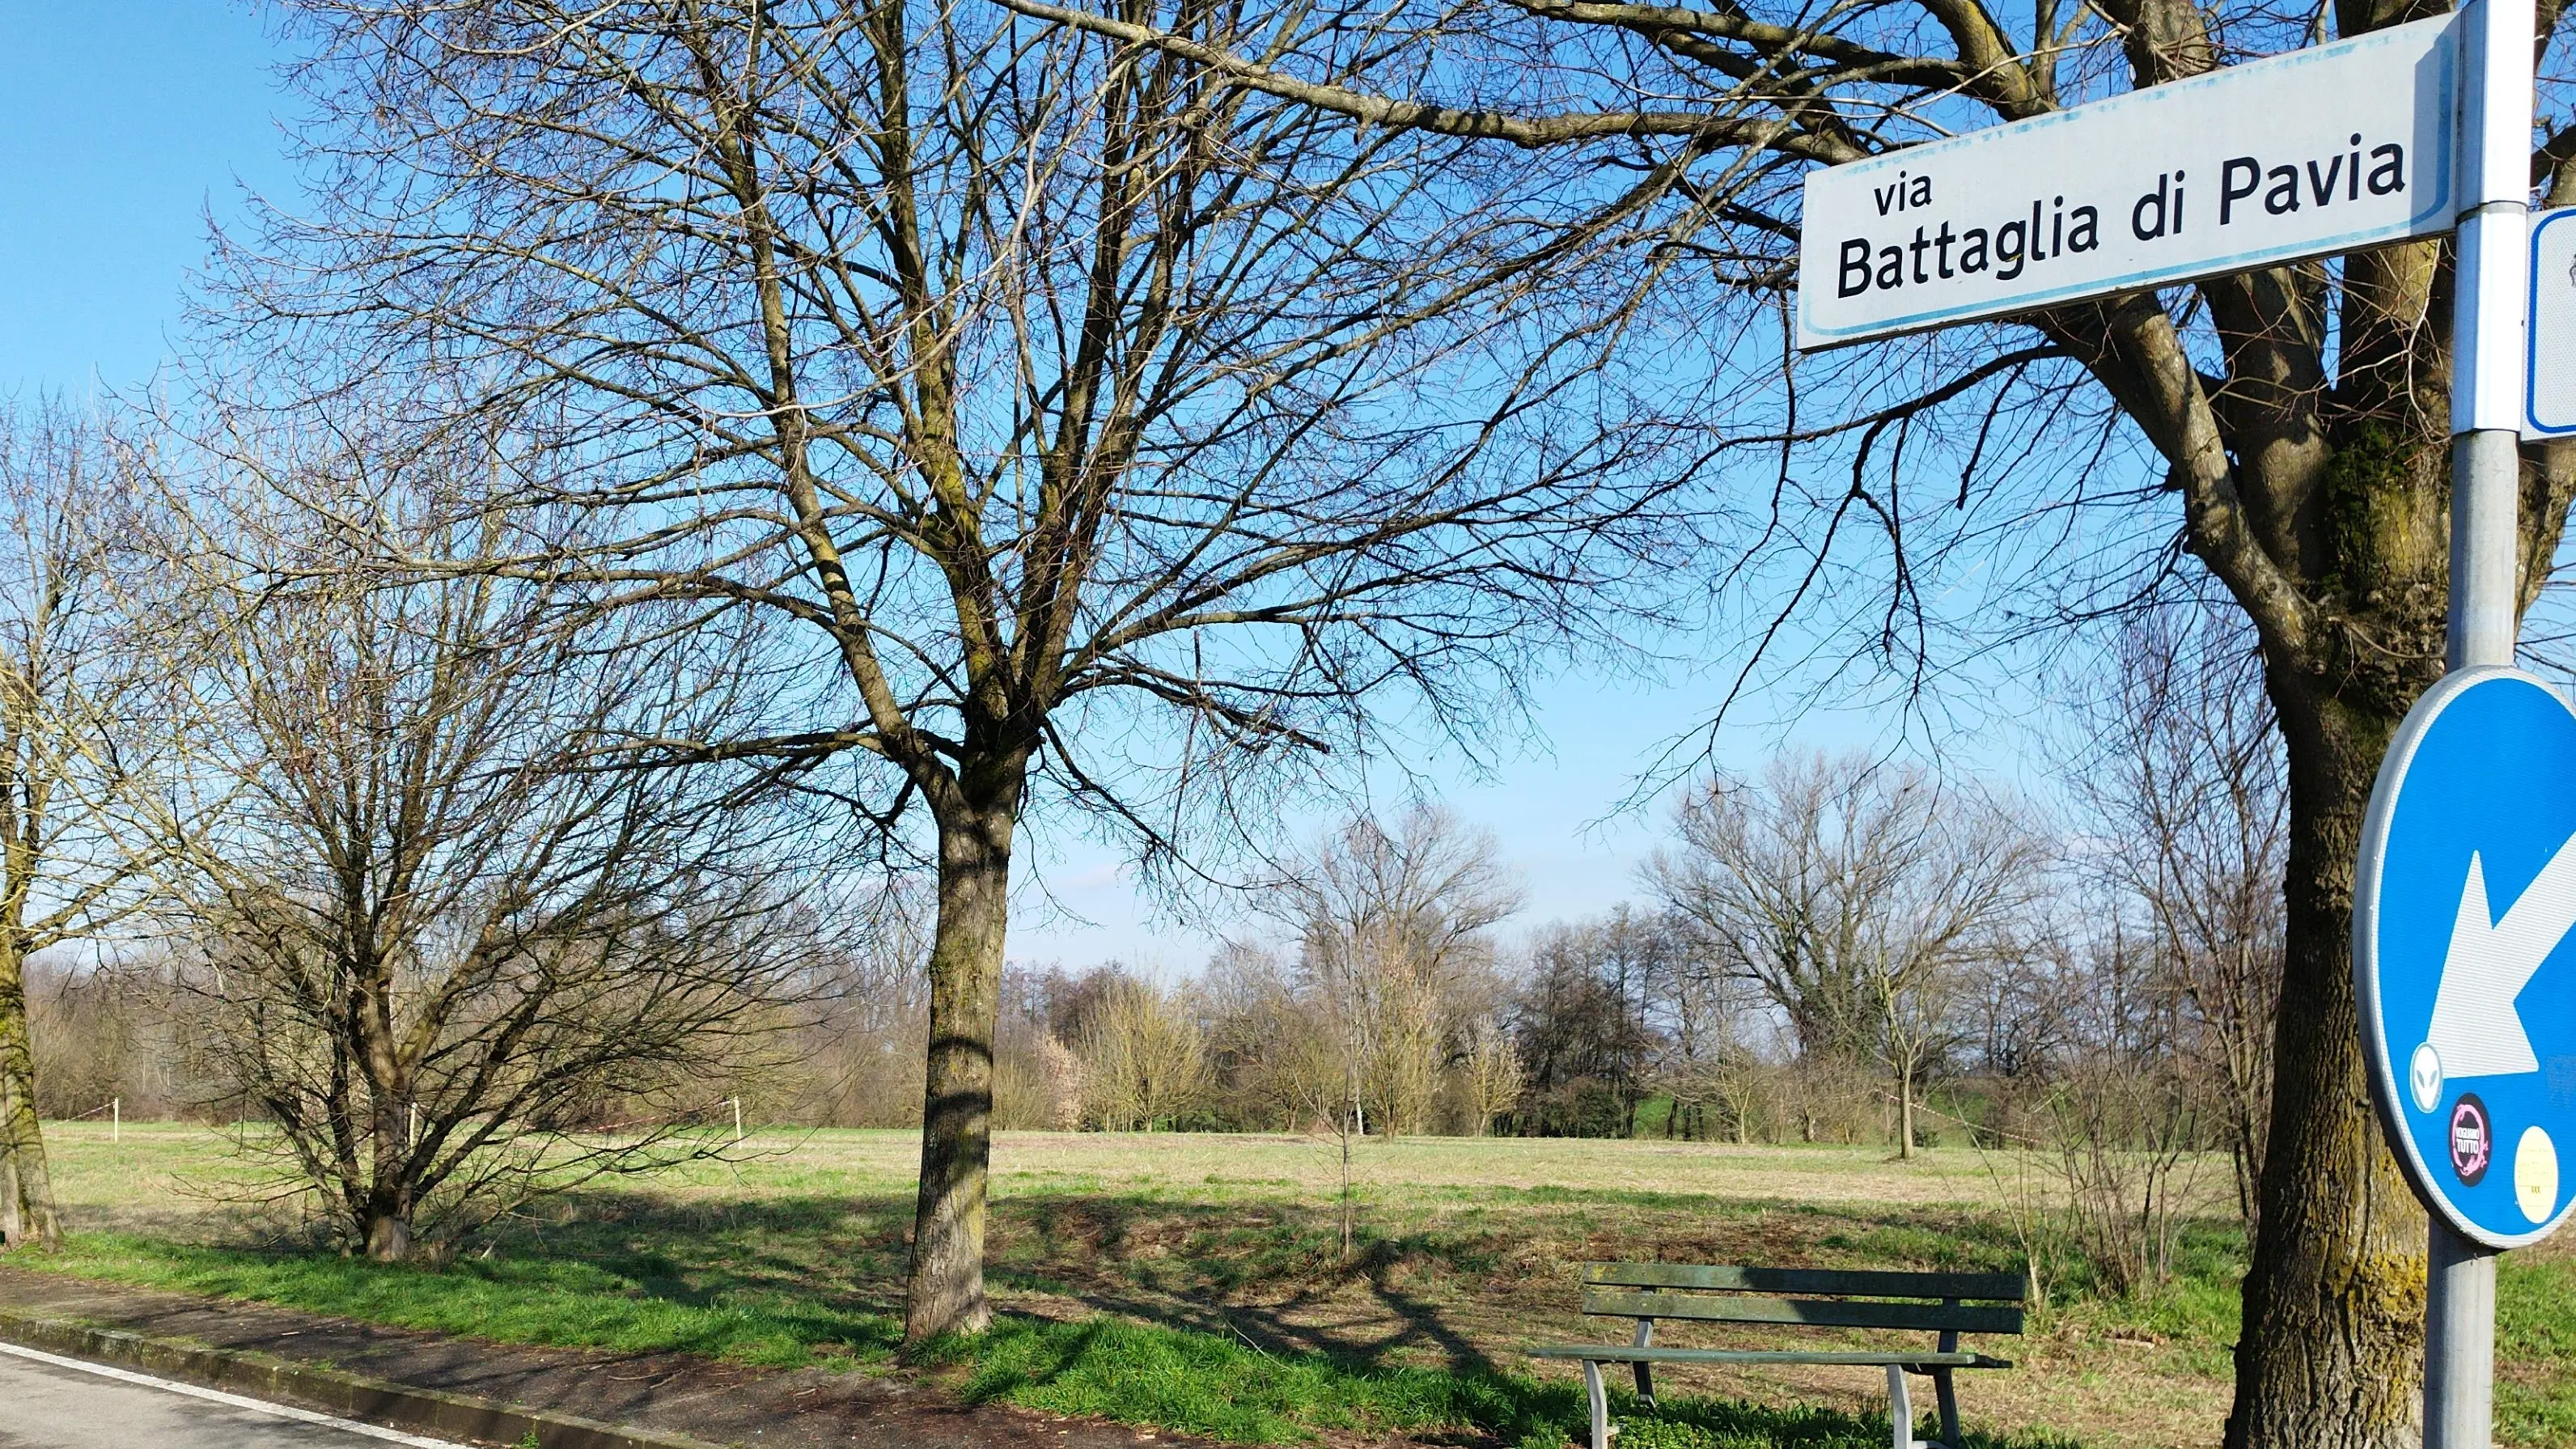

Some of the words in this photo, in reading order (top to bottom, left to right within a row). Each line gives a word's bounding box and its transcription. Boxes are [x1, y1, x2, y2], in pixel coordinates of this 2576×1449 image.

[1837, 195, 2099, 299] Battaglia
[2132, 169, 2185, 241] di
[2219, 133, 2406, 226] Pavia
[1874, 170, 1933, 217] via
[2455, 1138, 2480, 1155] TUTTO
